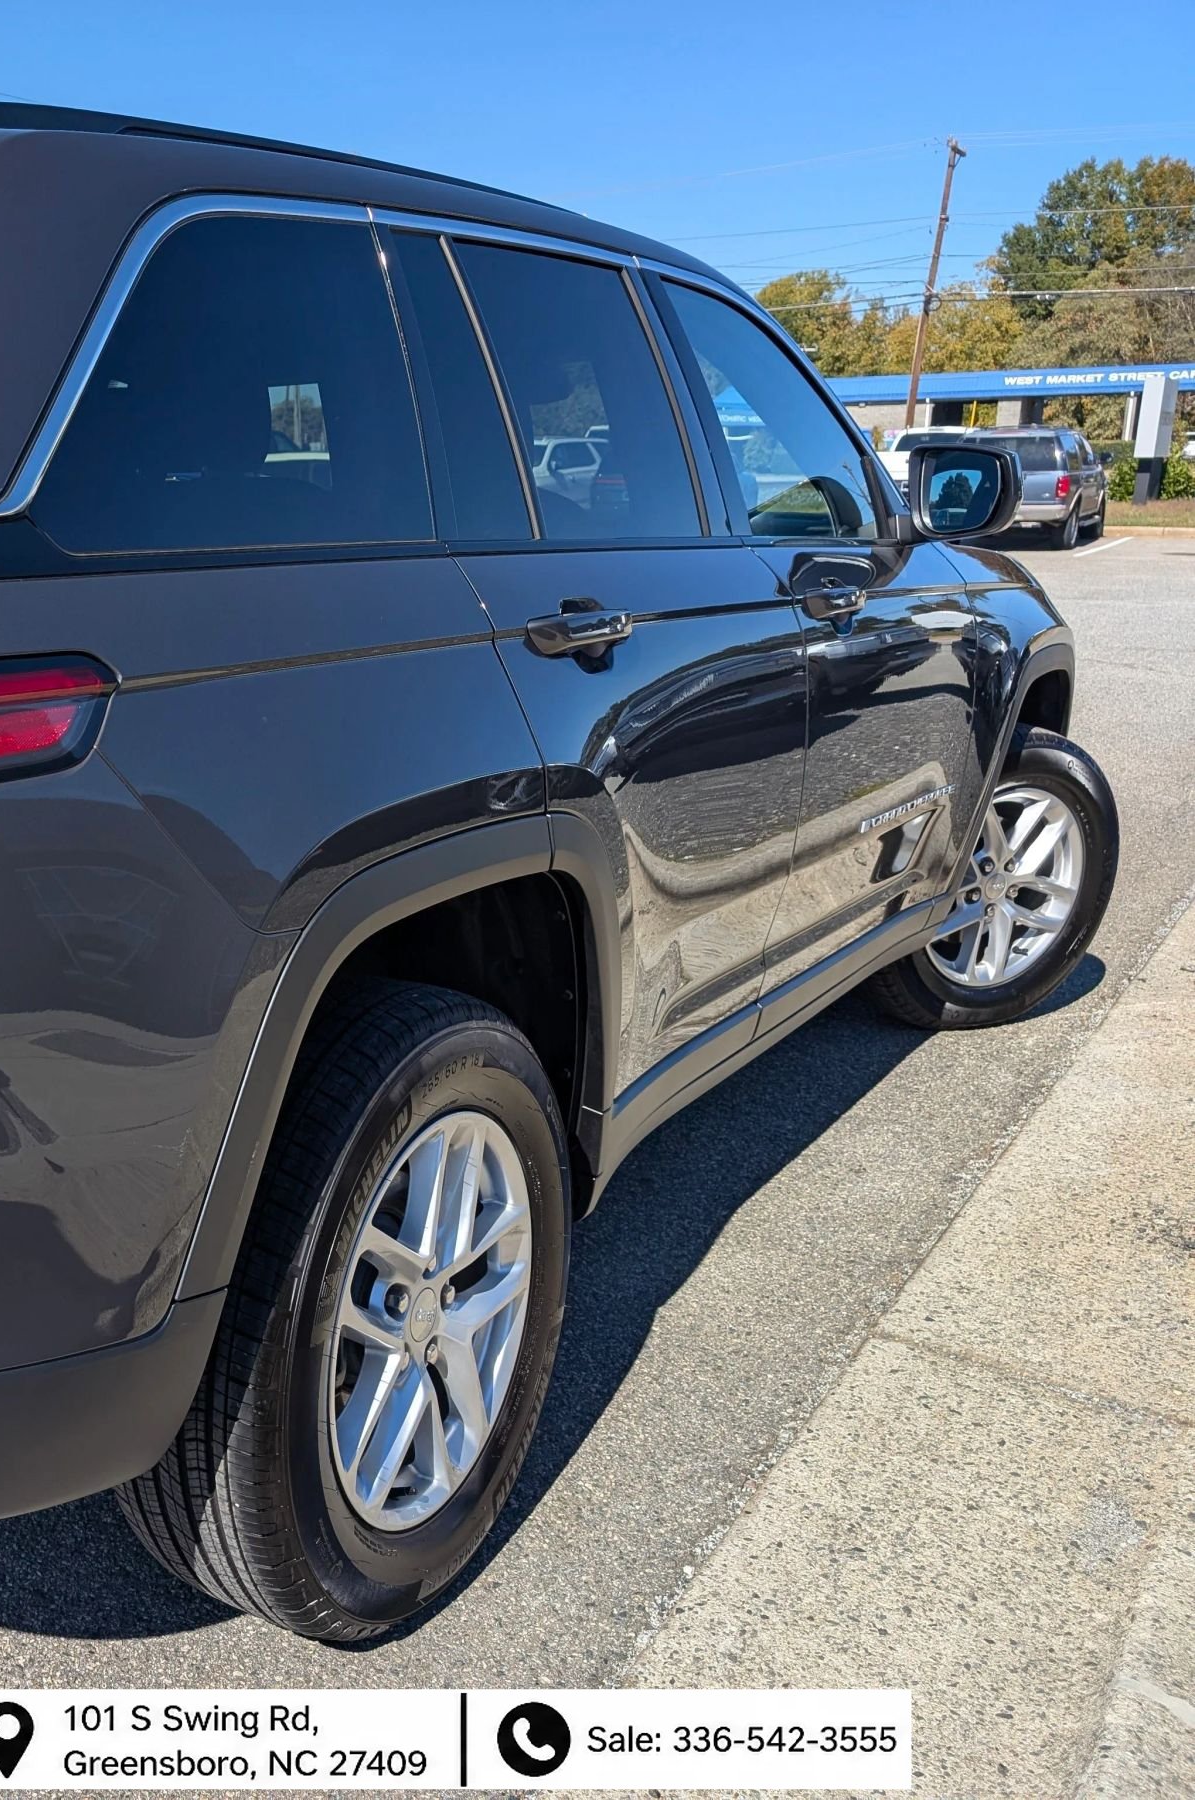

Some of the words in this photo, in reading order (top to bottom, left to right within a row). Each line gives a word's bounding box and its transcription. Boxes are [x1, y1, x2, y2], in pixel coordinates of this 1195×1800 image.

[1004, 375, 1043, 385] WEST
[1046, 373, 1105, 384] MARKET
[335, 1104, 409, 1262] MICHELIN
[496, 1371, 550, 1512] MICHELIN
